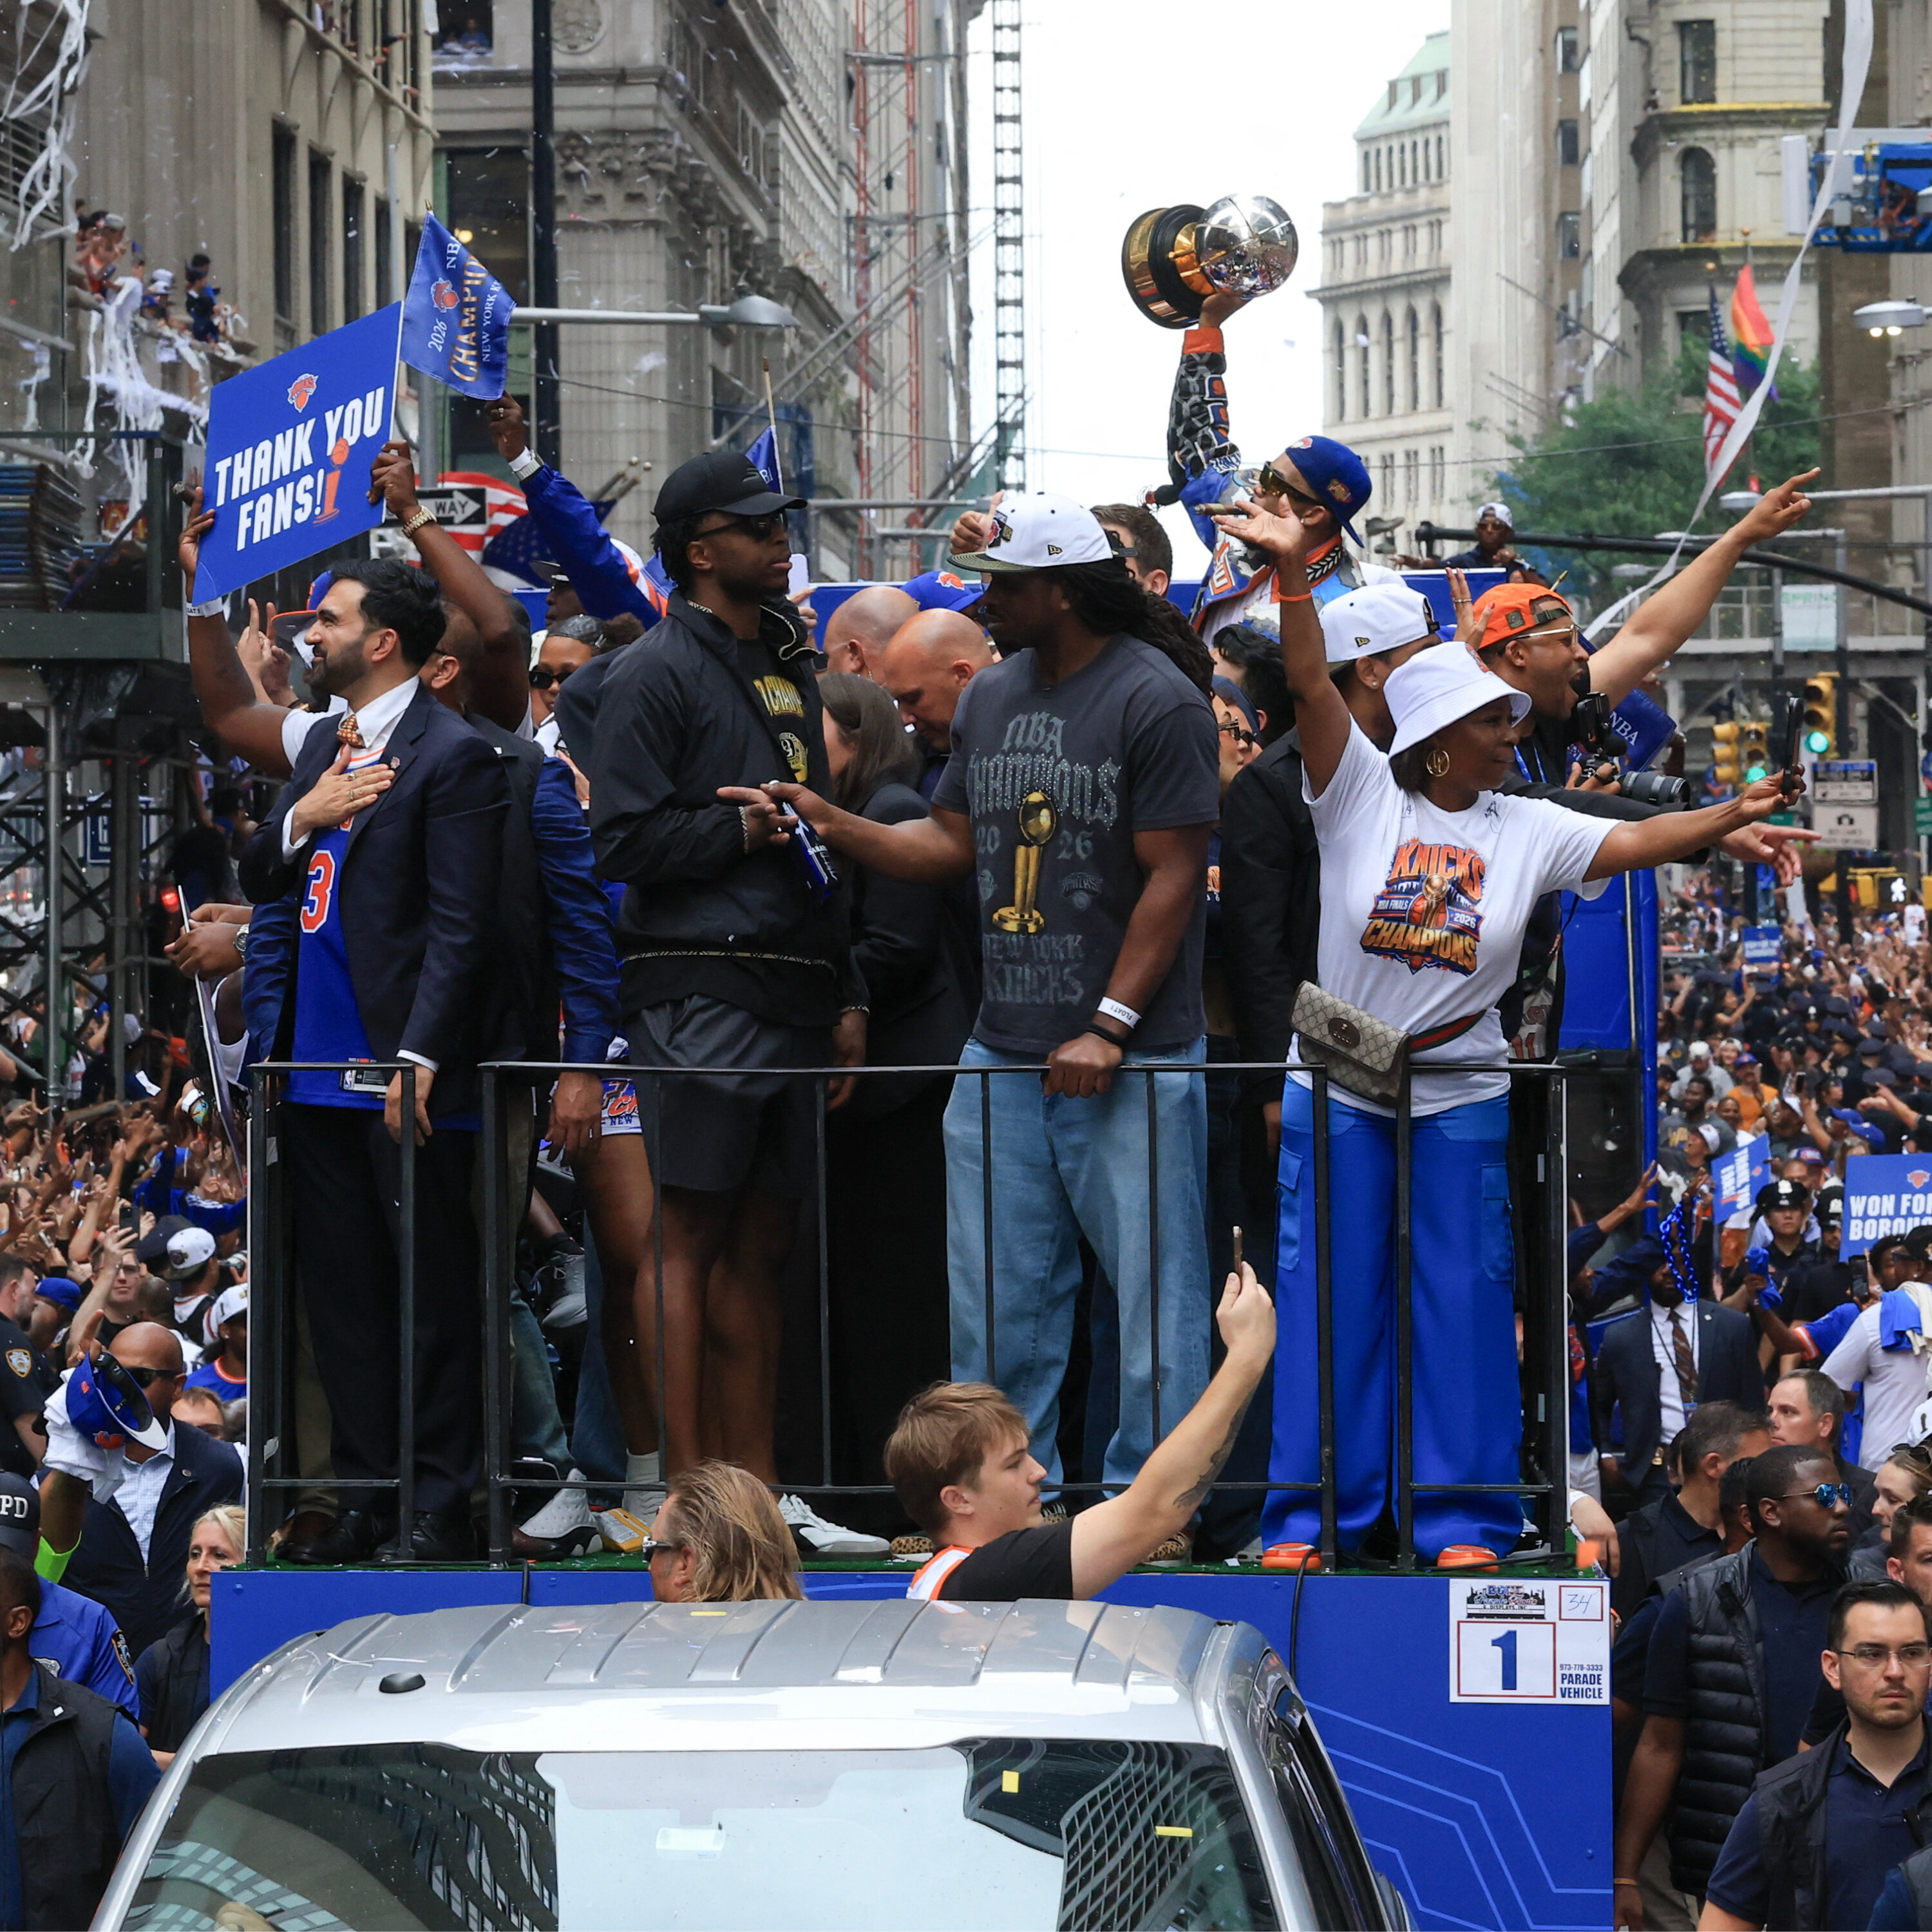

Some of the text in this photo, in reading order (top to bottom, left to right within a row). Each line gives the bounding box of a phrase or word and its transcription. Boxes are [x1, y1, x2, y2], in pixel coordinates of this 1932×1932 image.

[449, 254, 489, 382] CHAMPIO
[483, 294, 498, 327] YORK
[428, 318, 448, 353] 2026
[482, 331, 491, 362] NEW
[214, 386, 385, 507] THANK YOU
[236, 469, 325, 552] FANS!
[435, 500, 469, 515] WAY
[1003, 710, 1067, 757] NBA
[1609, 711, 1640, 746] NBA
[976, 825, 1001, 855] 20
[1057, 830, 1095, 860] 26
[1387, 842, 1485, 902] KNICKS
[299, 849, 336, 933] 3
[1377, 899, 1409, 911] NBA FINALS
[1454, 913, 1477, 929] 2026
[1361, 919, 1477, 972] CHAMPIONS
[610, 1116, 633, 1126] NEW
[1850, 1194, 1895, 1217] WON
[0, 1495, 28, 1519] PD
[1567, 1593, 1593, 1614] 34
[1491, 1630, 1517, 1690] 1
[1560, 1663, 1603, 1672] 973-778-3333
[1560, 1687, 1603, 1699] VEHICLE
[1561, 1673, 1602, 1685] PARADE
